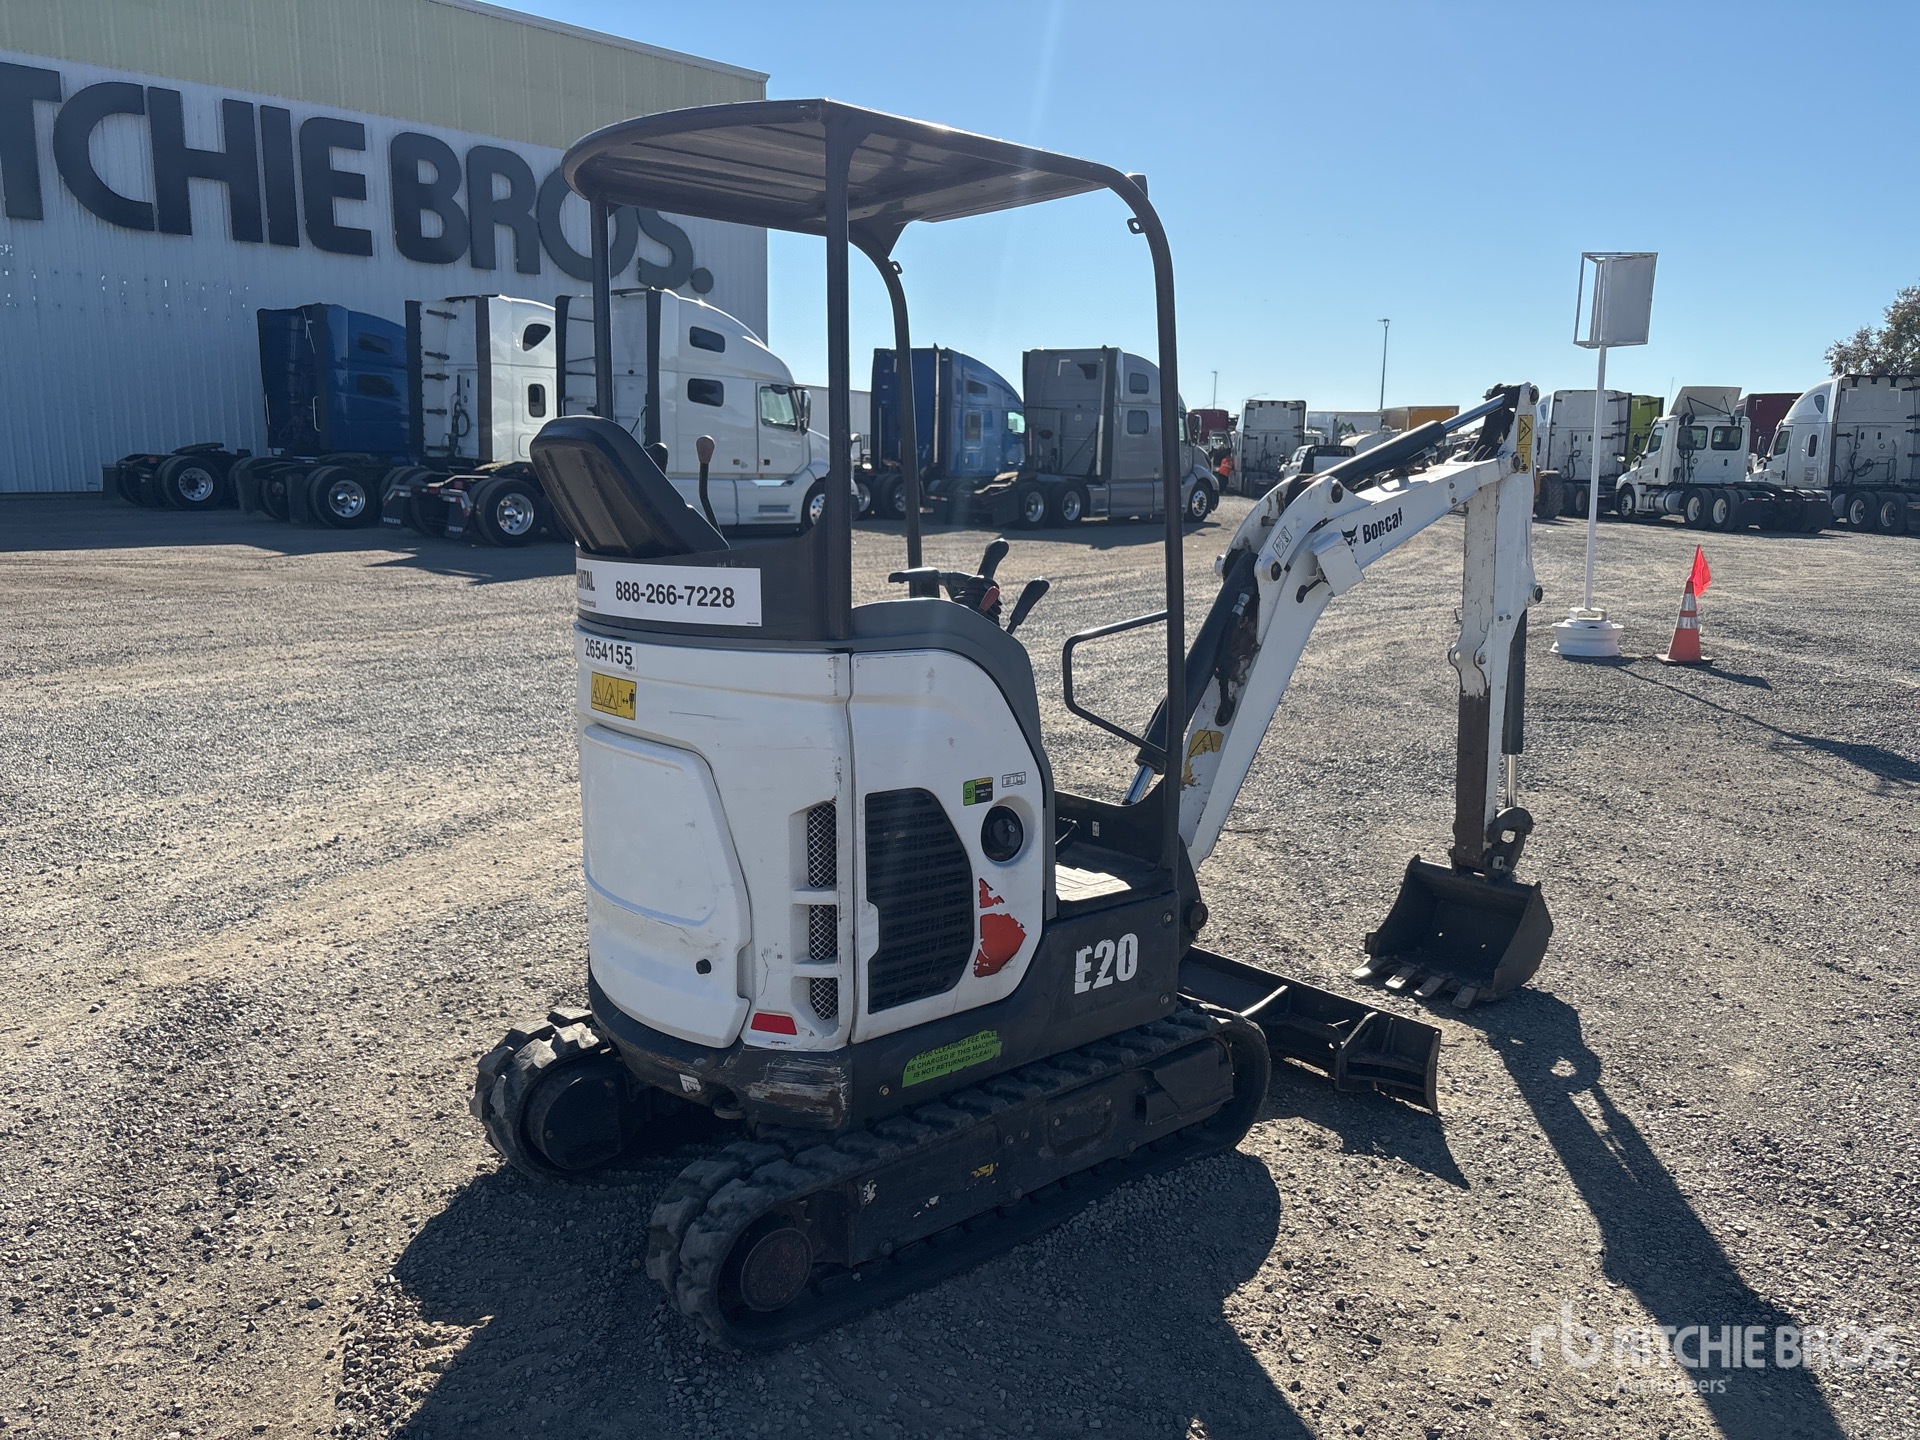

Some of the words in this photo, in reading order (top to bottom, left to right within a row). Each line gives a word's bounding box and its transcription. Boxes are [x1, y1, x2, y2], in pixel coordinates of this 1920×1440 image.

[390, 131, 714, 294] BROS.
[615, 580, 735, 609] 888-266-7228
[584, 637, 633, 666] 2654155
[1074, 933, 1138, 995] E20
[967, 1035, 979, 1045] FEE
[980, 1031, 996, 1041] WILL
[906, 1063, 915, 1073] BE
[917, 1053, 949, 1069] CHARGED
[949, 1051, 957, 1059] IF
[957, 1046, 971, 1056] THIS
[972, 1039, 1000, 1052] MACHINE
[913, 1070, 920, 1079] IS
[921, 1066, 934, 1076] NOT
[935, 1055, 971, 1071] RETURNED
